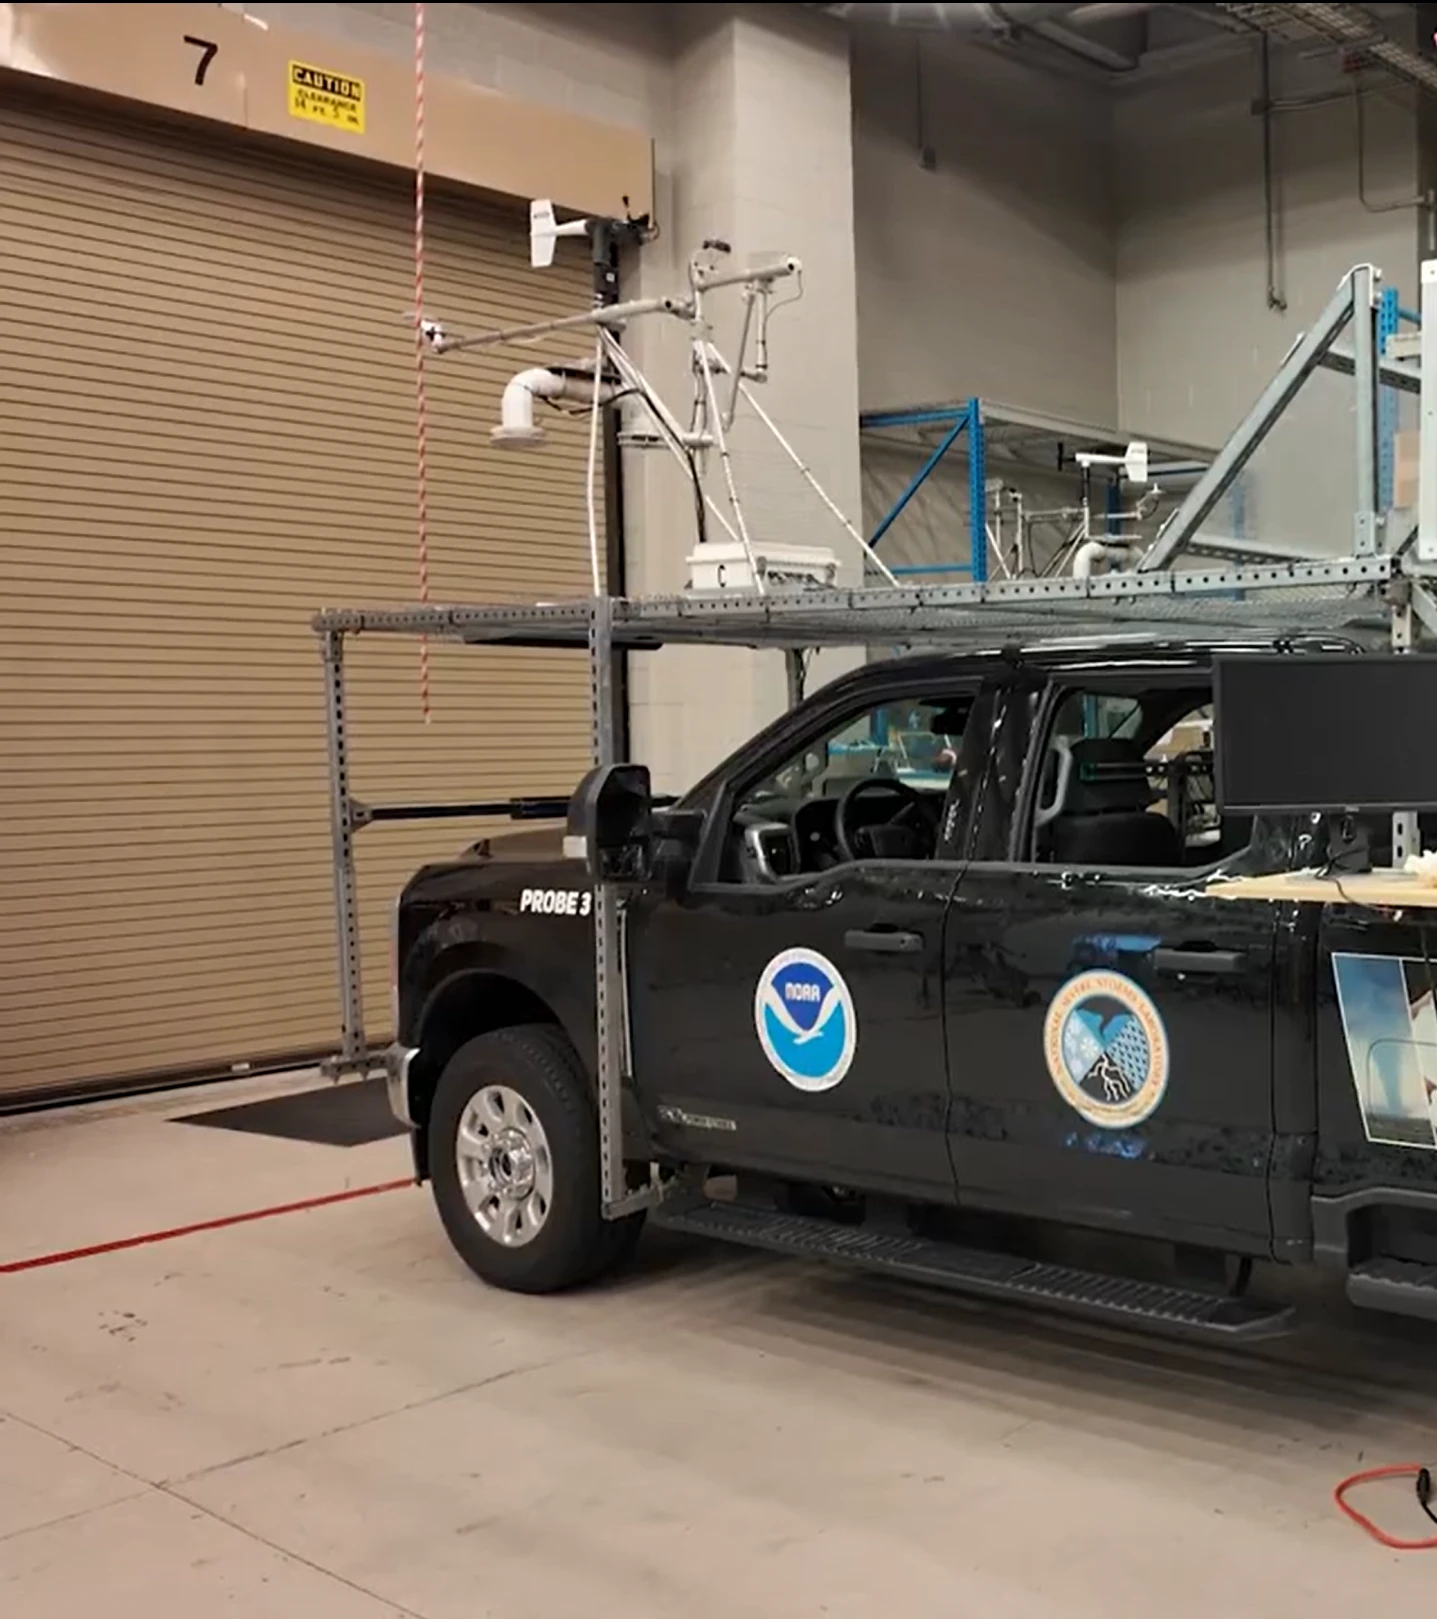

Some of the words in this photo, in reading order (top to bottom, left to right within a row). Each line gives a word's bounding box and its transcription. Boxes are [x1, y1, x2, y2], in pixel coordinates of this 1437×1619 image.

[183, 35, 218, 86] 7
[294, 68, 361, 98] CAUTION
[520, 888, 579, 915] PROBE
[579, 891, 592, 916] 3
